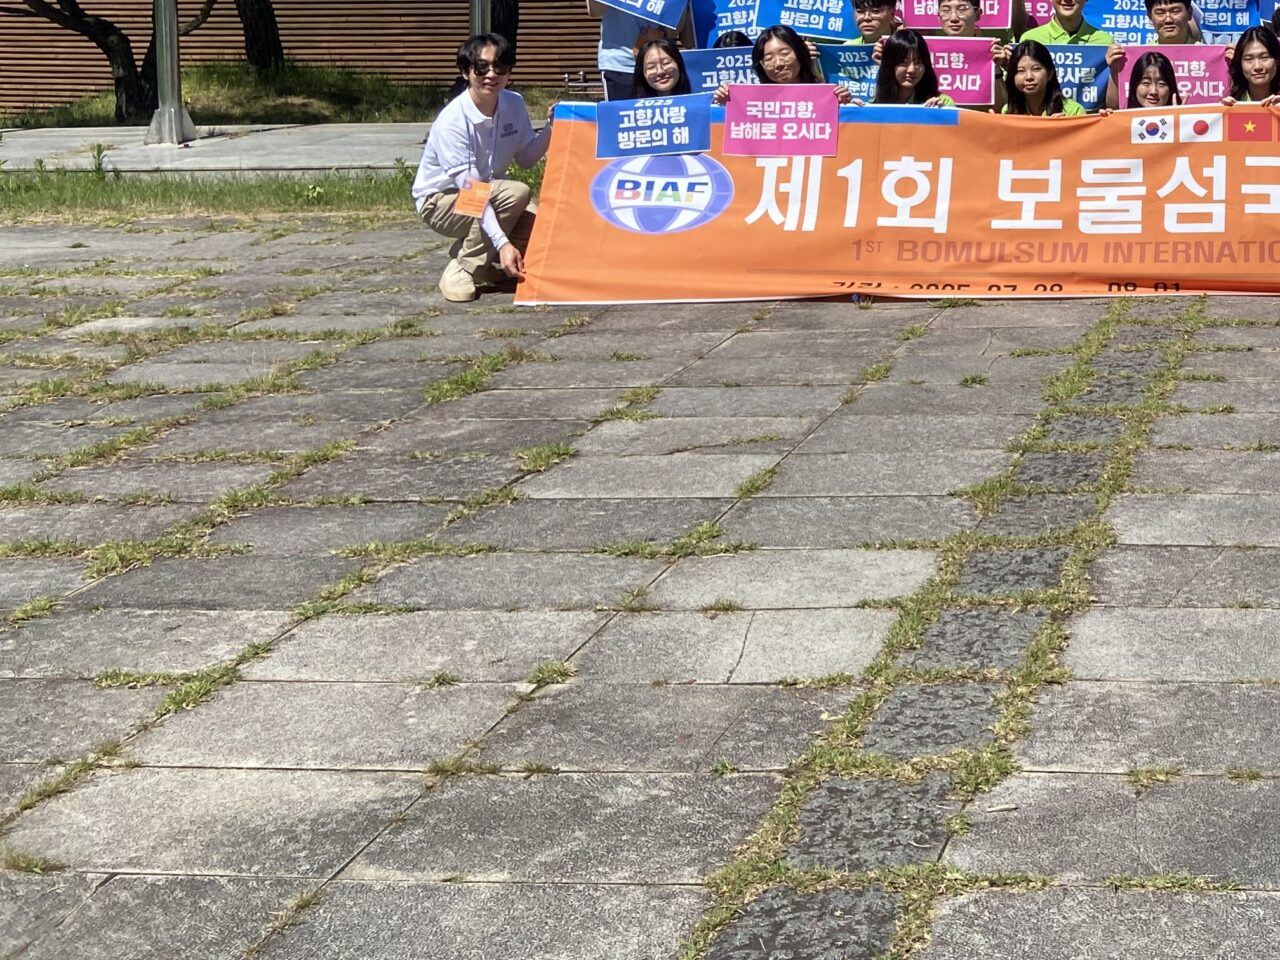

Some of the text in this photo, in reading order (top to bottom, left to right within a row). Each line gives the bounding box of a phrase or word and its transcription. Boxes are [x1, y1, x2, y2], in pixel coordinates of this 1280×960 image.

[780, 11, 843, 32] 방문의 해
[1200, 12, 1249, 26] 문의 해
[716, 55, 753, 68] 2025
[837, 52, 869, 63] 2025
[938, 74, 981, 91] 오시다
[1082, 86, 1097, 102] 해
[619, 106, 686, 128] 고향사랑
[746, 101, 816, 119] 국민고향,
[618, 127, 689, 149] 방문의 해
[730, 122, 832, 140] 남해로 오시다
[613, 178, 709, 204] BIAF
[745, 156, 953, 233] 제1회
[897, 239, 1088, 264] BOMULSUM
